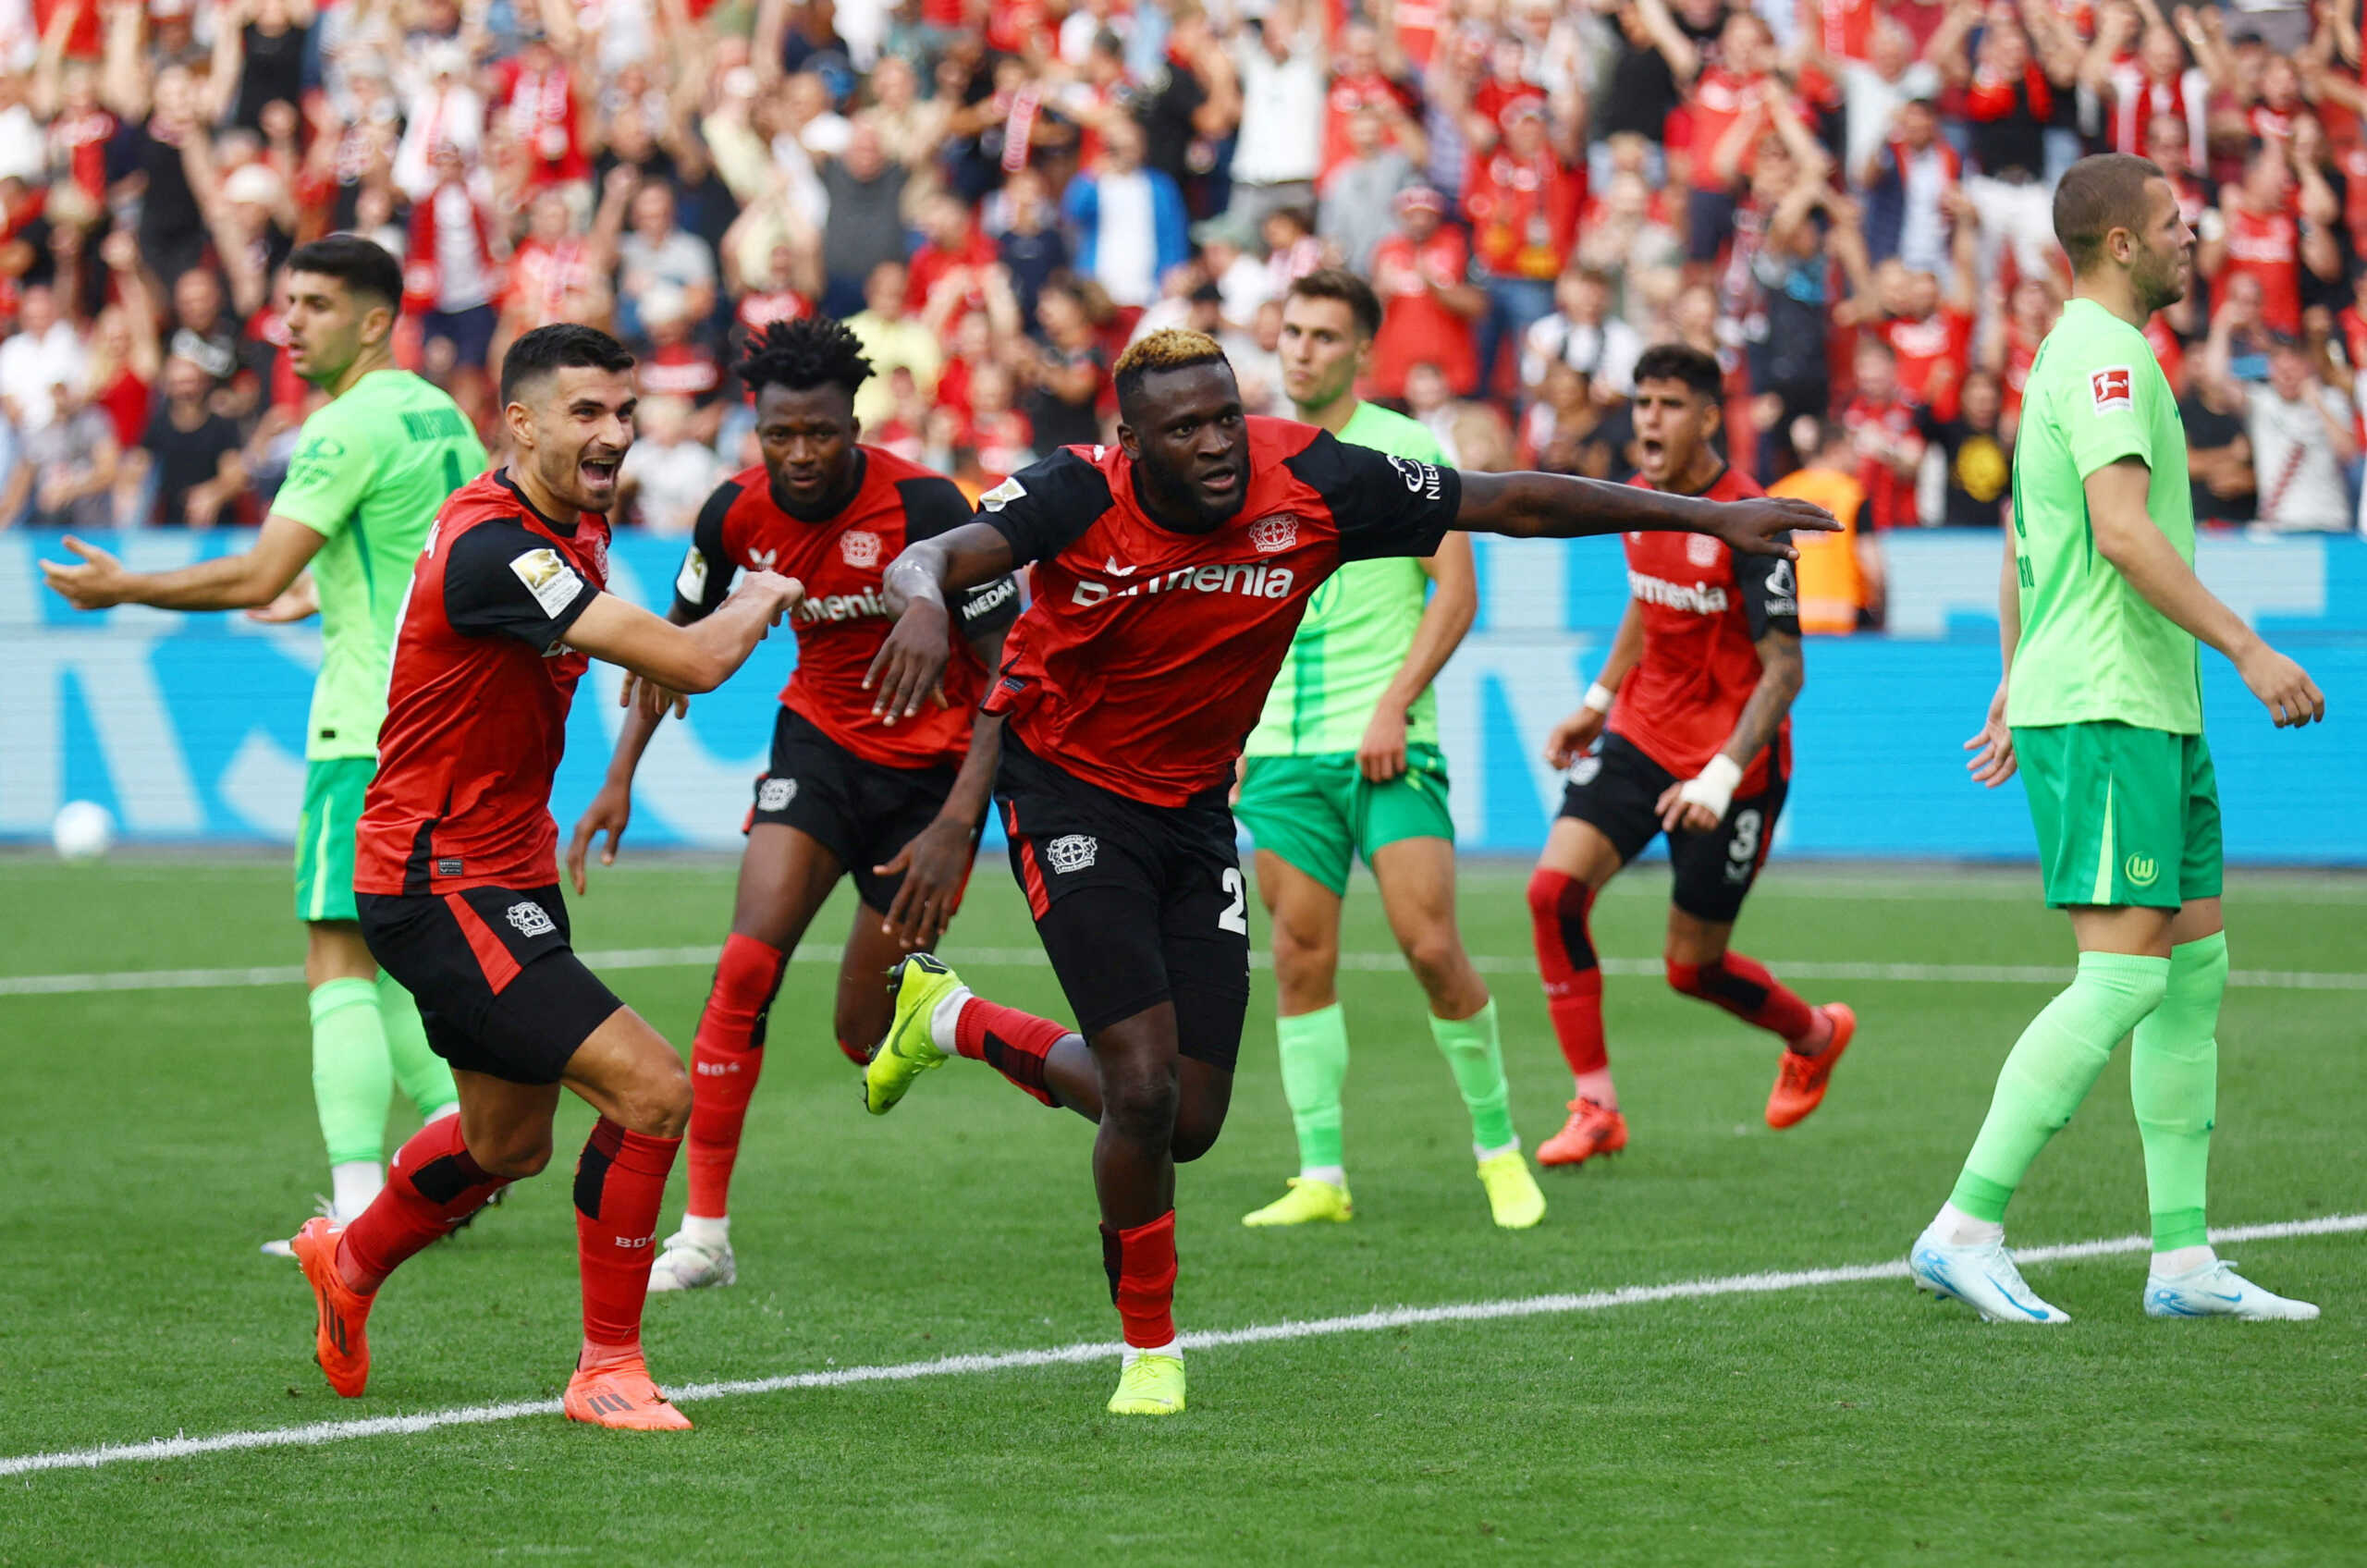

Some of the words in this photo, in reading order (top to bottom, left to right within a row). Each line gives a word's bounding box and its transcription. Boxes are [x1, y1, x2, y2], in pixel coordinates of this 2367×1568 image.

[962, 579, 1016, 621] NIEDAX
[1728, 808, 1761, 862] 3
[1218, 867, 1246, 936] 2
